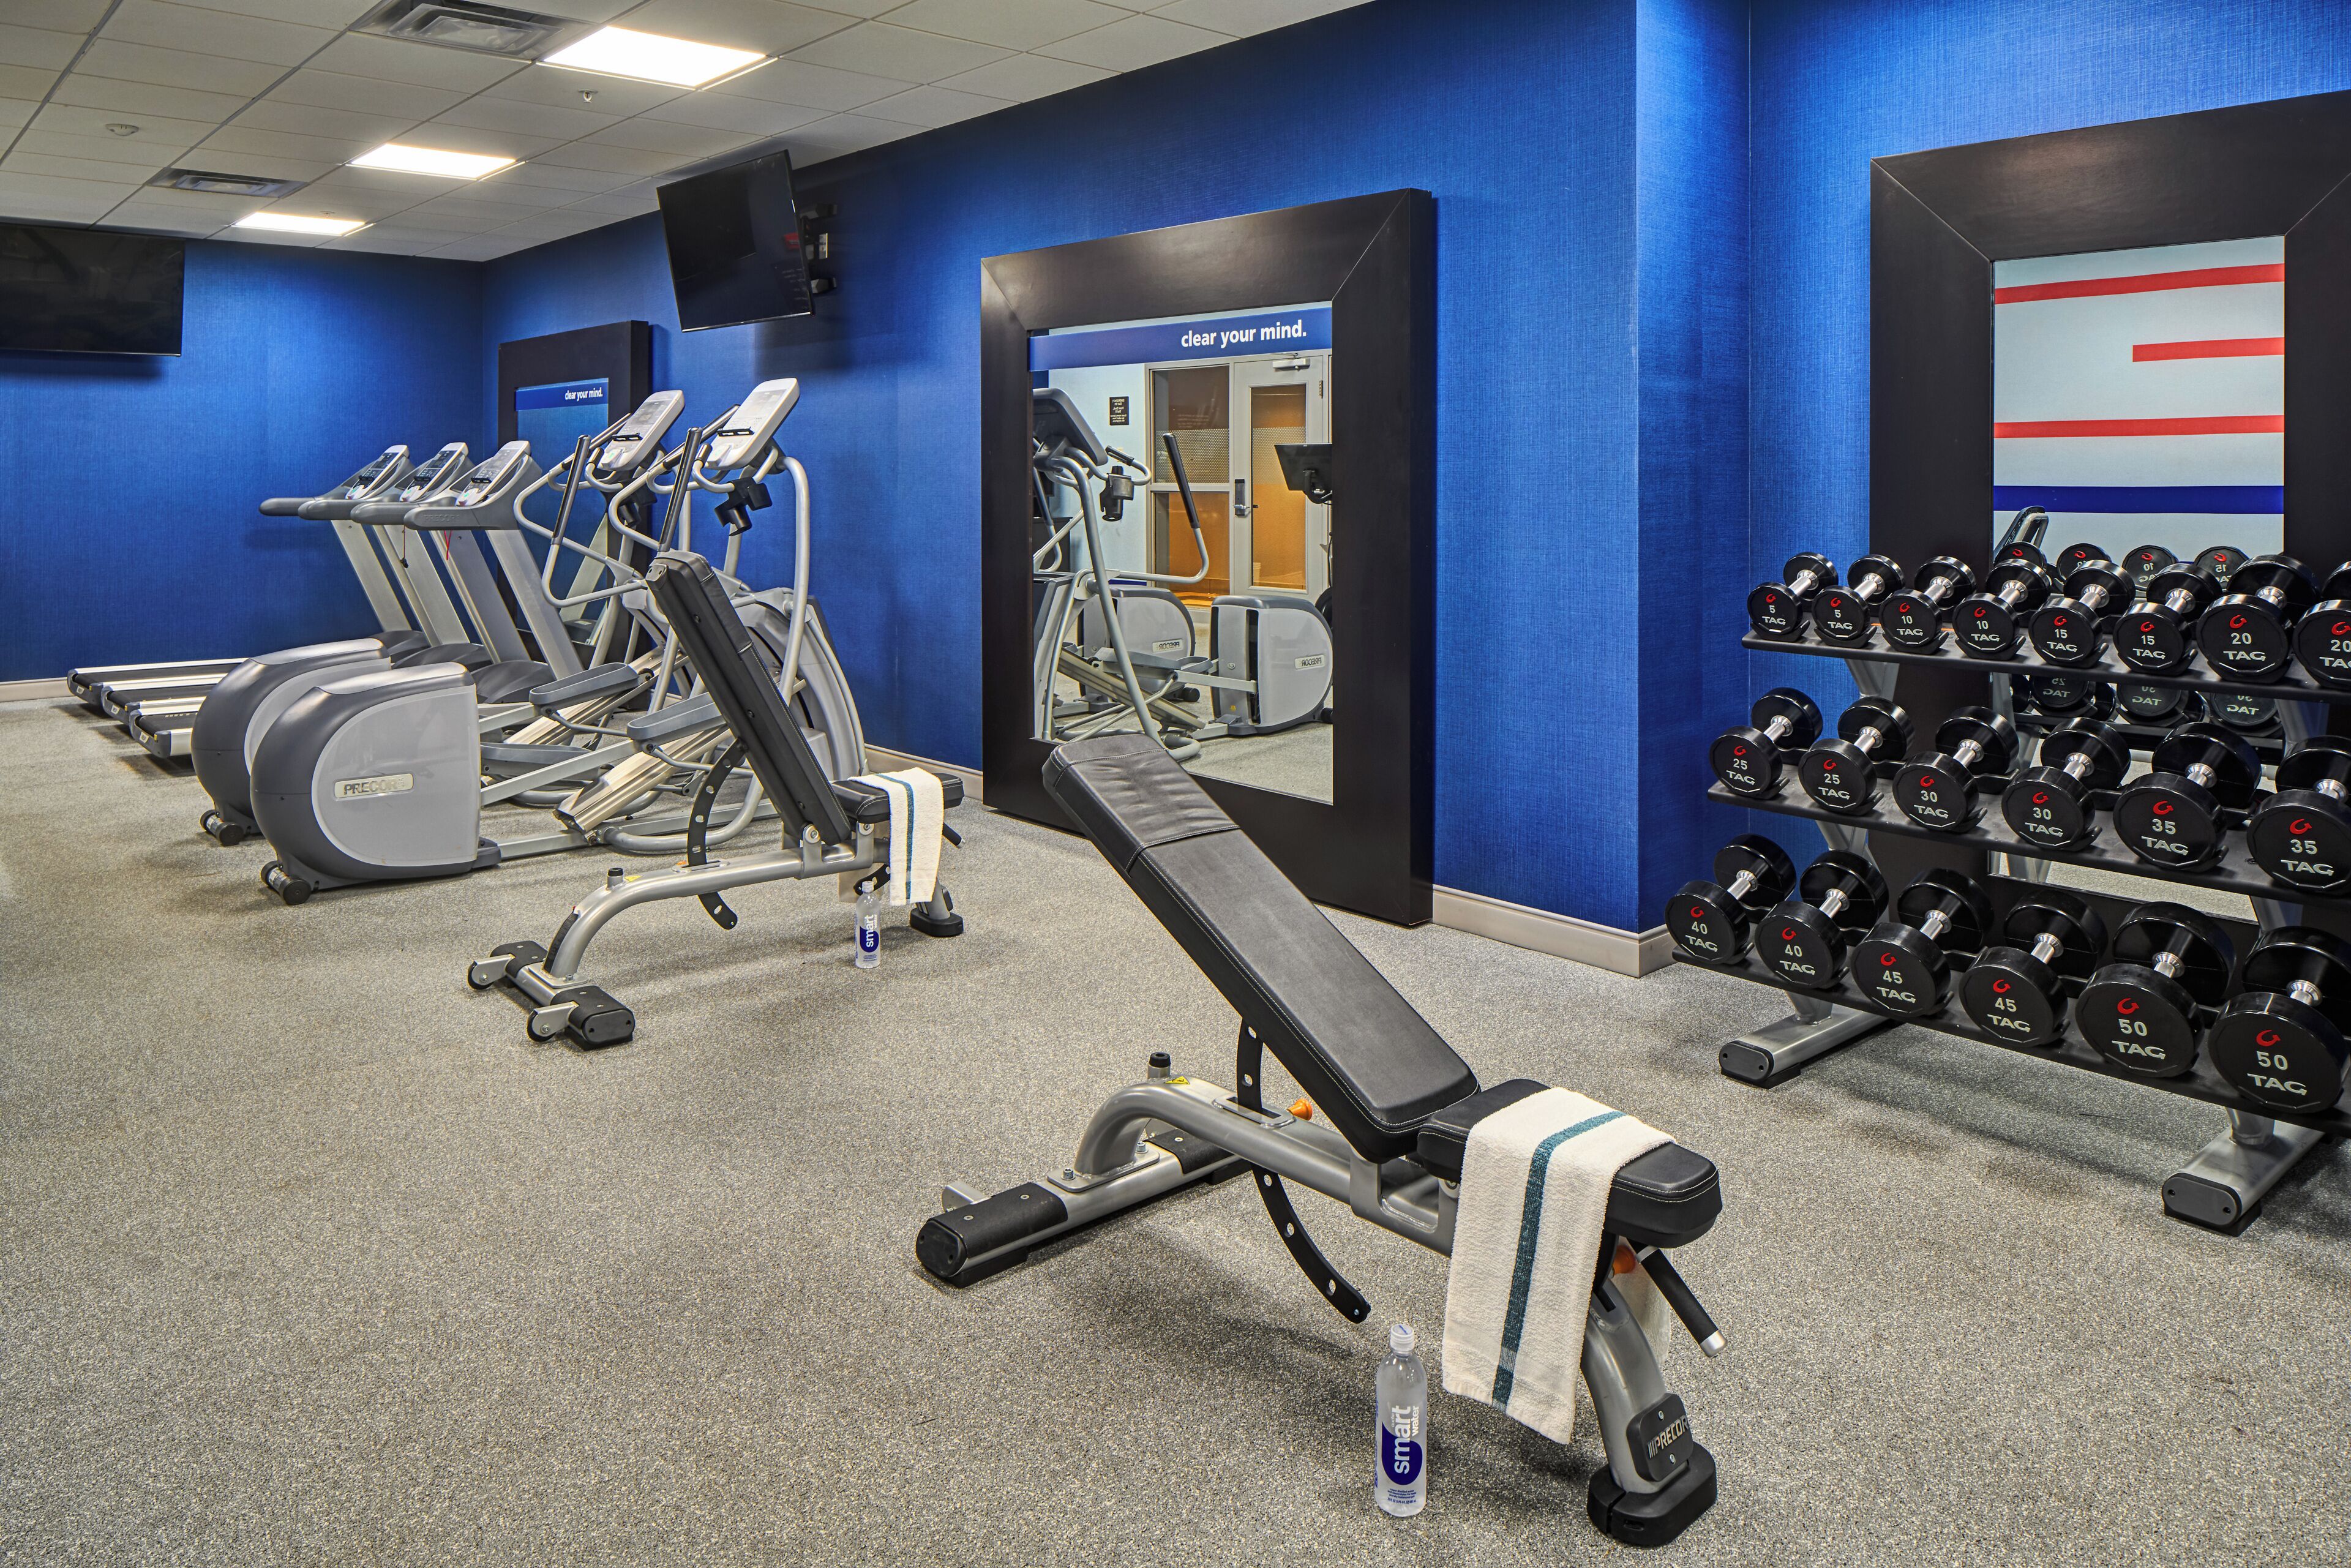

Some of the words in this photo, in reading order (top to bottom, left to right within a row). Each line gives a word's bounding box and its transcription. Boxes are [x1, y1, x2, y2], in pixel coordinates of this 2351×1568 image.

[1181, 330, 1217, 348] clear
[1220, 328, 1256, 349] your
[1260, 319, 1307, 341] mind.
[564, 390, 576, 400] clear
[577, 391, 588, 402] your
[588, 387, 603, 398] mind.
[1769, 604, 1775, 613] 5
[1834, 609, 1842, 618] 5
[1761, 615, 1786, 626] TAG
[1827, 621, 1853, 630] TAG
[1901, 615, 1913, 625] 10
[1976, 620, 1989, 629] 10
[1971, 634, 2000, 642] TAG
[2054, 629, 2068, 639] 15
[2141, 635, 2155, 645] 15
[2230, 632, 2252, 645] 20
[2046, 641, 2078, 653] TAG
[2330, 639, 2351, 653] 20
[2132, 648, 2166, 659] TAG
[2222, 651, 2267, 661] TAG
[2319, 656, 2351, 669] TA
[1733, 758, 1748, 770] 25
[1726, 770, 1755, 786] TAG
[1824, 773, 1840, 785] 25
[343, 778, 398, 795] PRECOR
[1818, 787, 1850, 800] TAG
[1921, 790, 1938, 803] 30
[1913, 805, 1949, 819] TAG
[2033, 807, 2052, 820] 30
[2025, 822, 2064, 838] TAG
[2151, 819, 2176, 835] 35
[2141, 836, 2189, 856] TAG
[2290, 839, 2317, 855] 35
[2280, 859, 2334, 876] TAG
[864, 914, 874, 948] smart
[1691, 921, 1708, 935] 40
[1685, 934, 1718, 953] TAG
[1785, 944, 1802, 957] 40
[1779, 960, 1816, 975] TAG
[1883, 970, 1903, 985] 45
[1876, 986, 1916, 1003] TAG
[1995, 997, 2017, 1012] 45
[1987, 1014, 2031, 1033] TAG
[2118, 1018, 2147, 1037] 50
[2111, 1040, 2166, 1060] TAG
[2256, 1051, 2288, 1070] 50
[2247, 1073, 2308, 1096] TAG
[1411, 1406, 1420, 1437] water
[1392, 1405, 1411, 1474] smart
[1654, 1415, 1689, 1455] PRECOR
